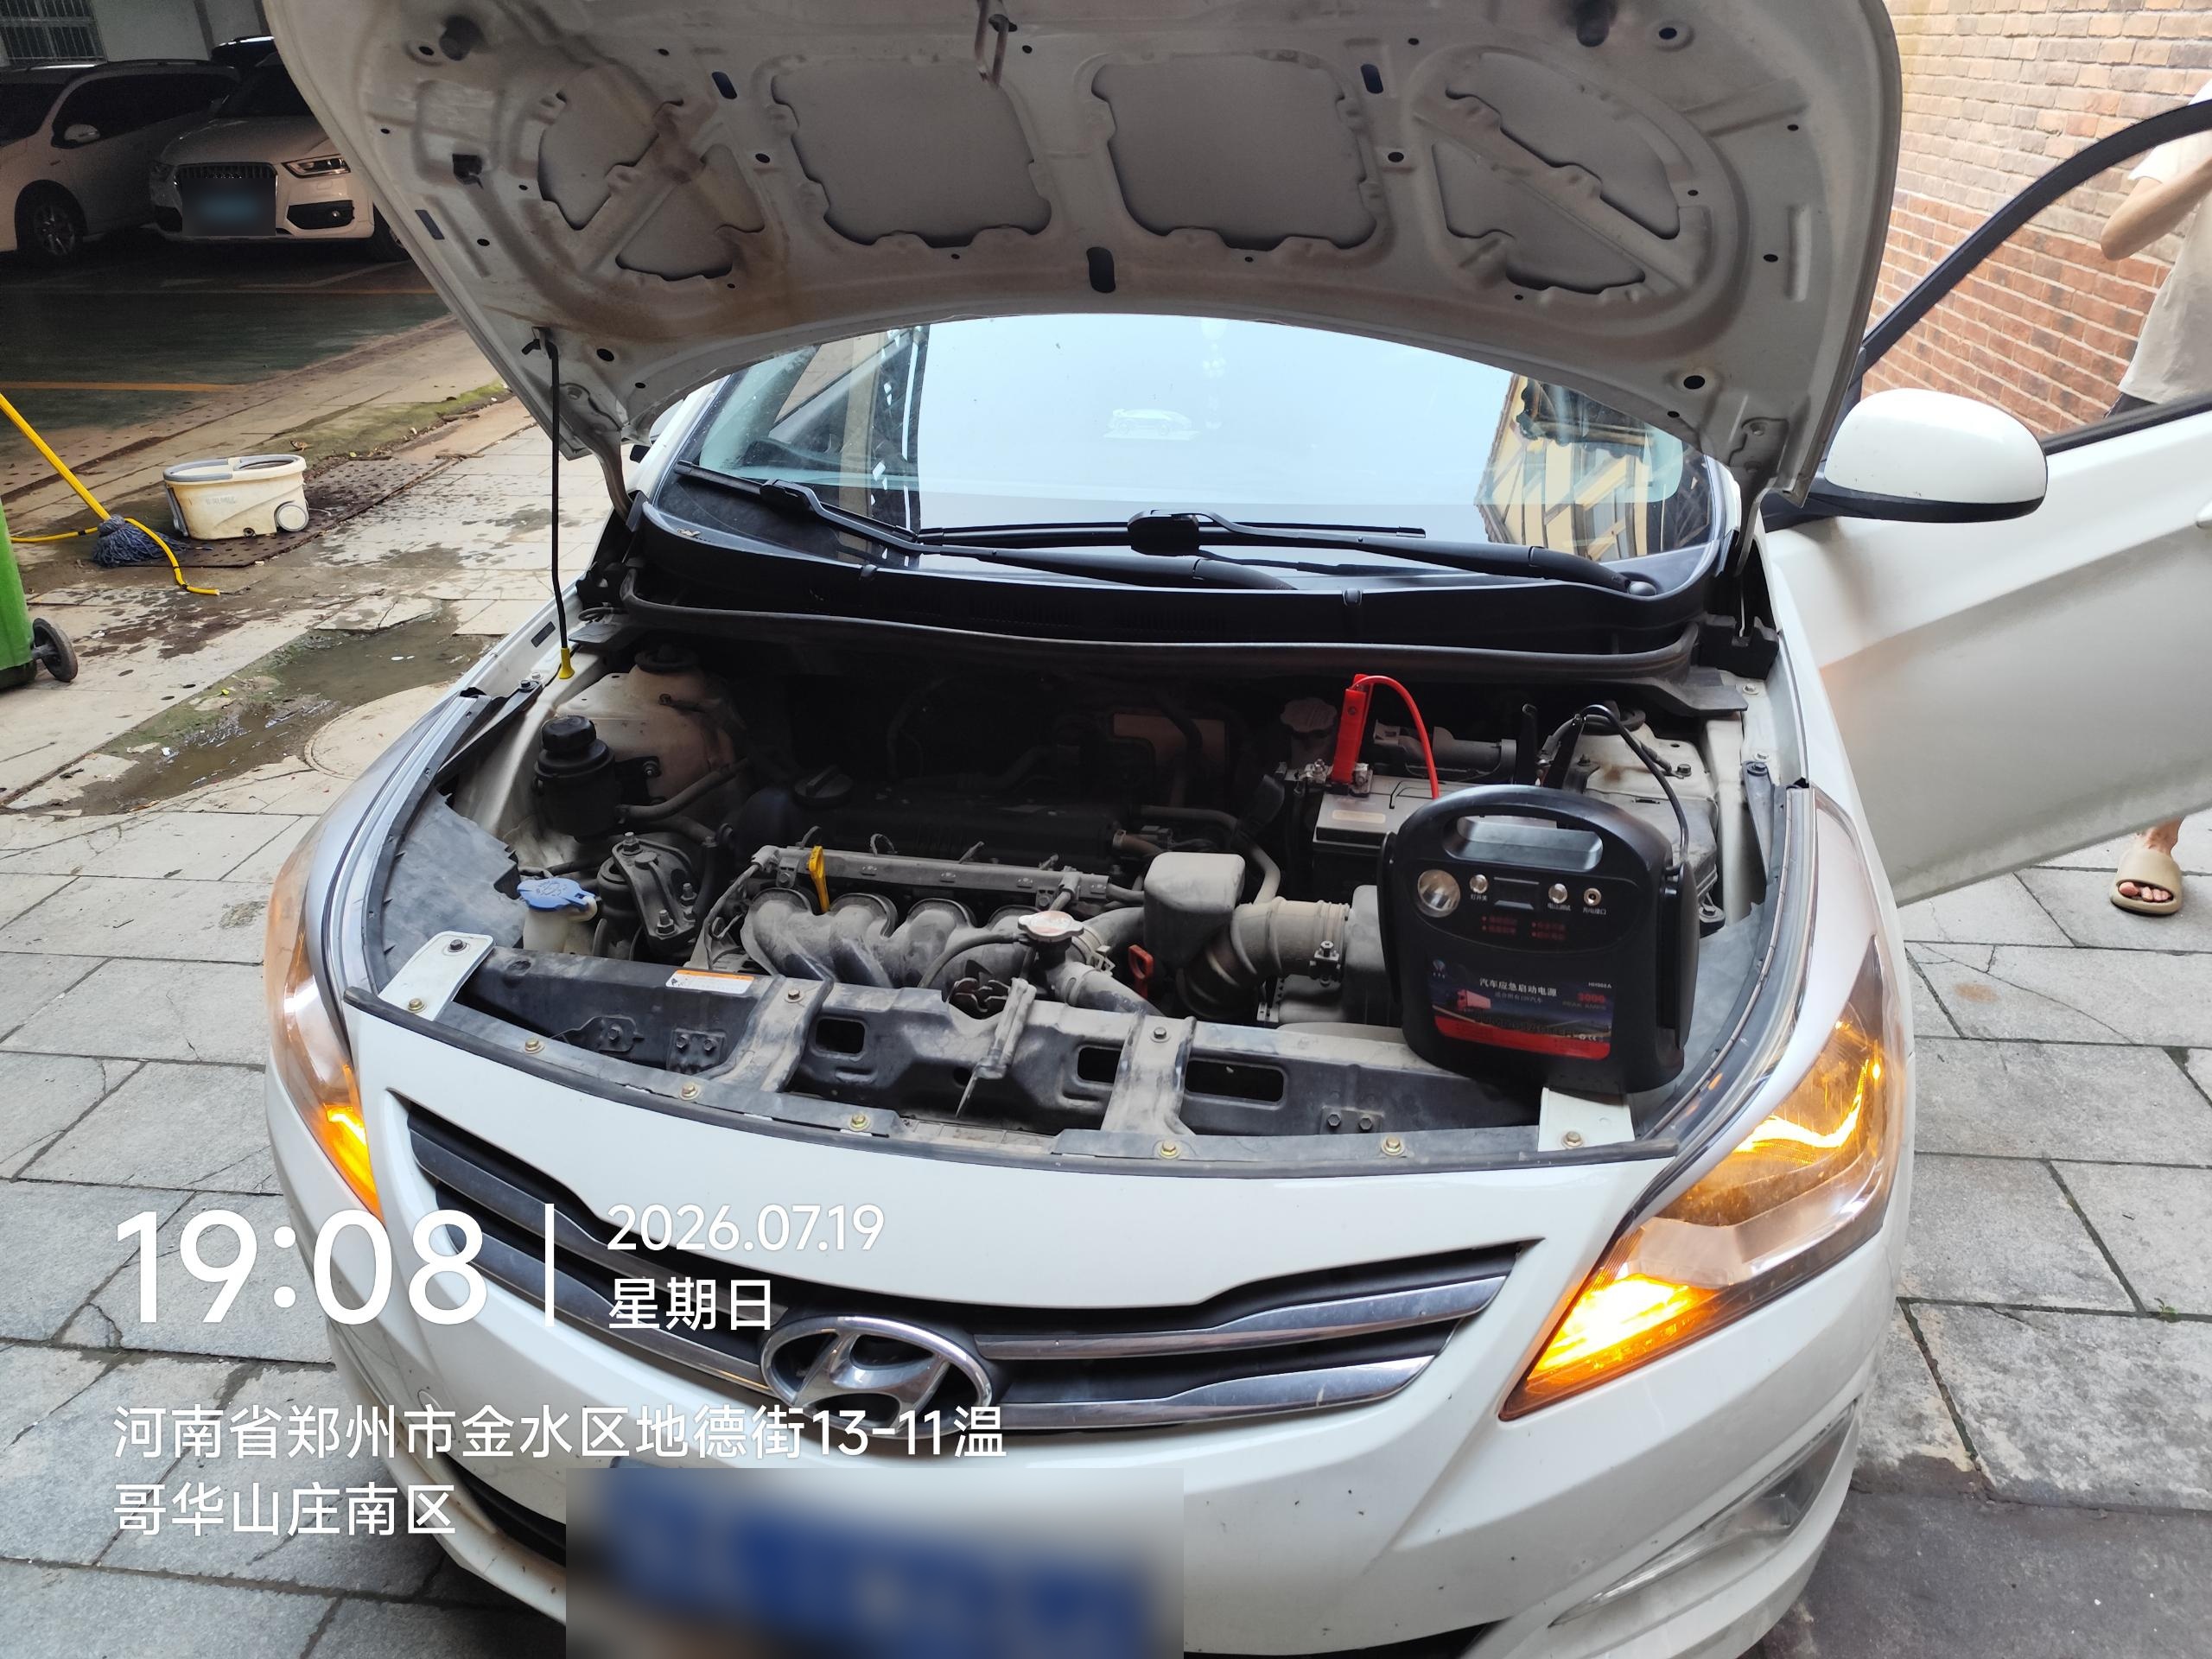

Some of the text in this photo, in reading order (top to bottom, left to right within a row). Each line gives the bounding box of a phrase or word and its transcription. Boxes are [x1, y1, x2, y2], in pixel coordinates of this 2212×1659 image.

[1479, 977, 1558, 998] 汽车应急启动电源
